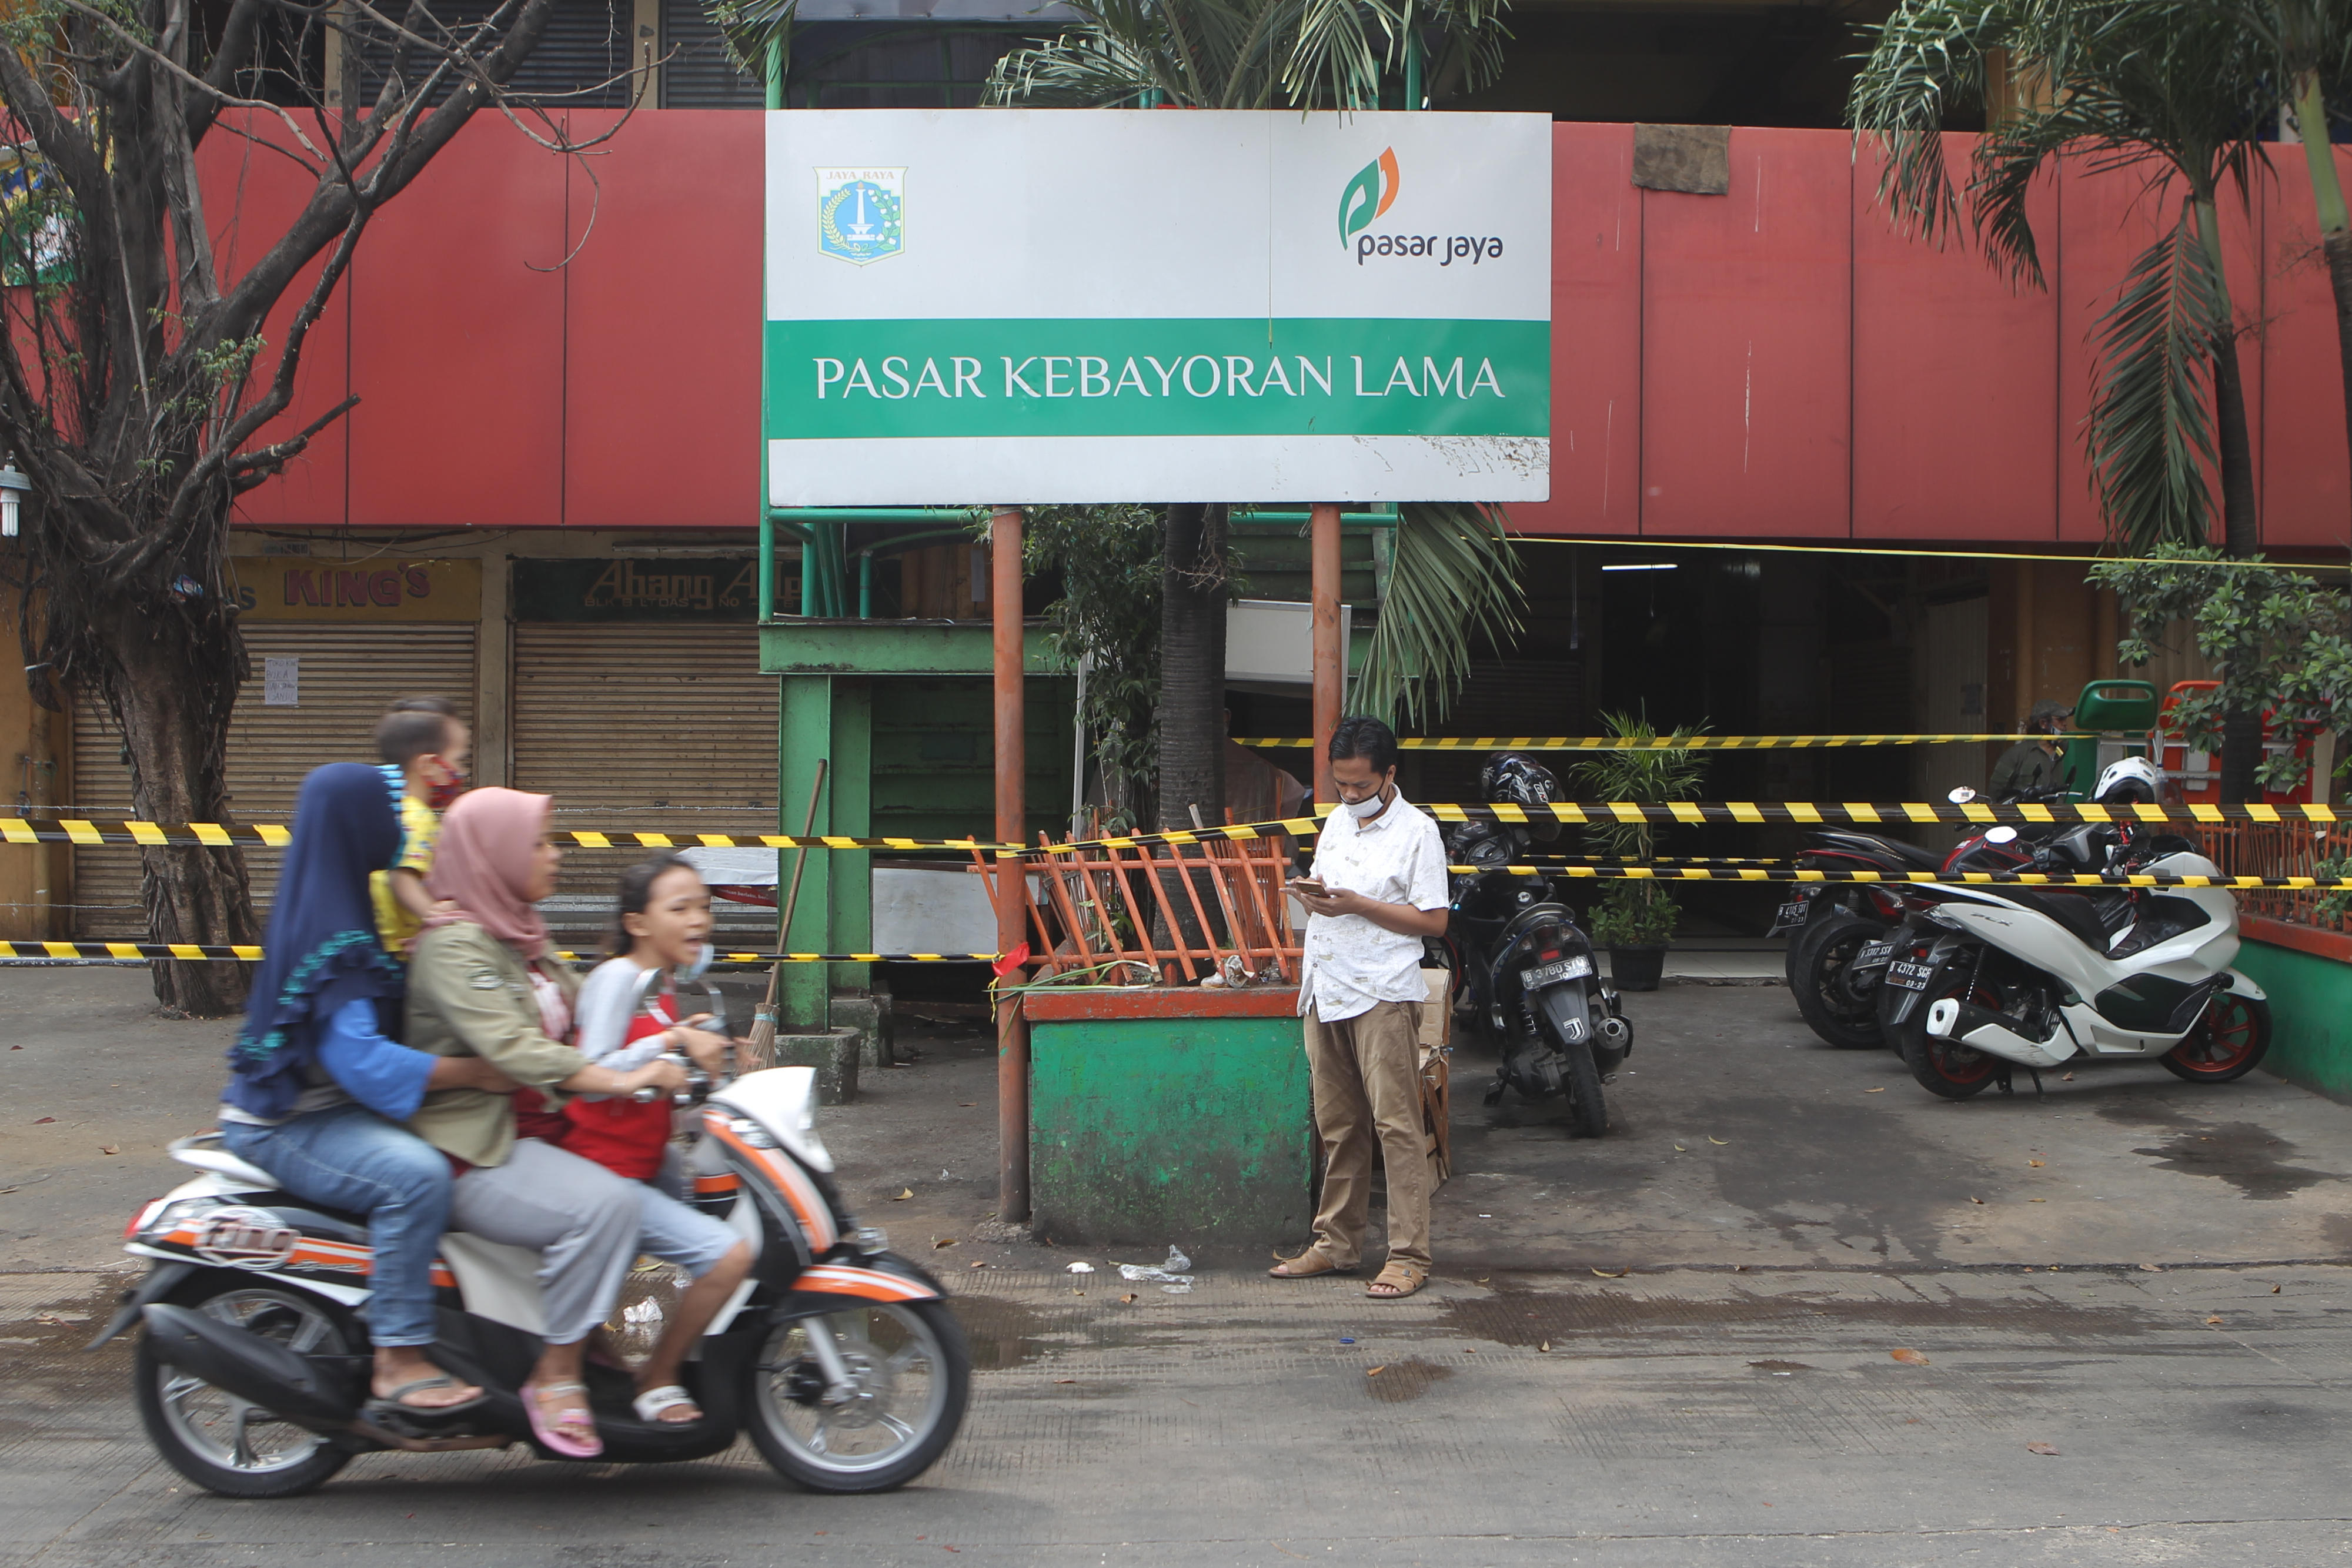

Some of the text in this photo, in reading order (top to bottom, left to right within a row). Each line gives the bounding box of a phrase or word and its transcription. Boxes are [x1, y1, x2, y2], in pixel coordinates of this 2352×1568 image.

[826, 171, 895, 180] JAYA RAYA
[1358, 235, 1504, 266] pasar jaya
[813, 355, 1506, 399] PASAR KEBAYORAN LAMA
[284, 562, 430, 607] KING'S
[719, 597, 739, 607] NO
[1889, 961, 1896, 972] B
[1897, 963, 1916, 976] 4372
[1525, 972, 1533, 982] B
